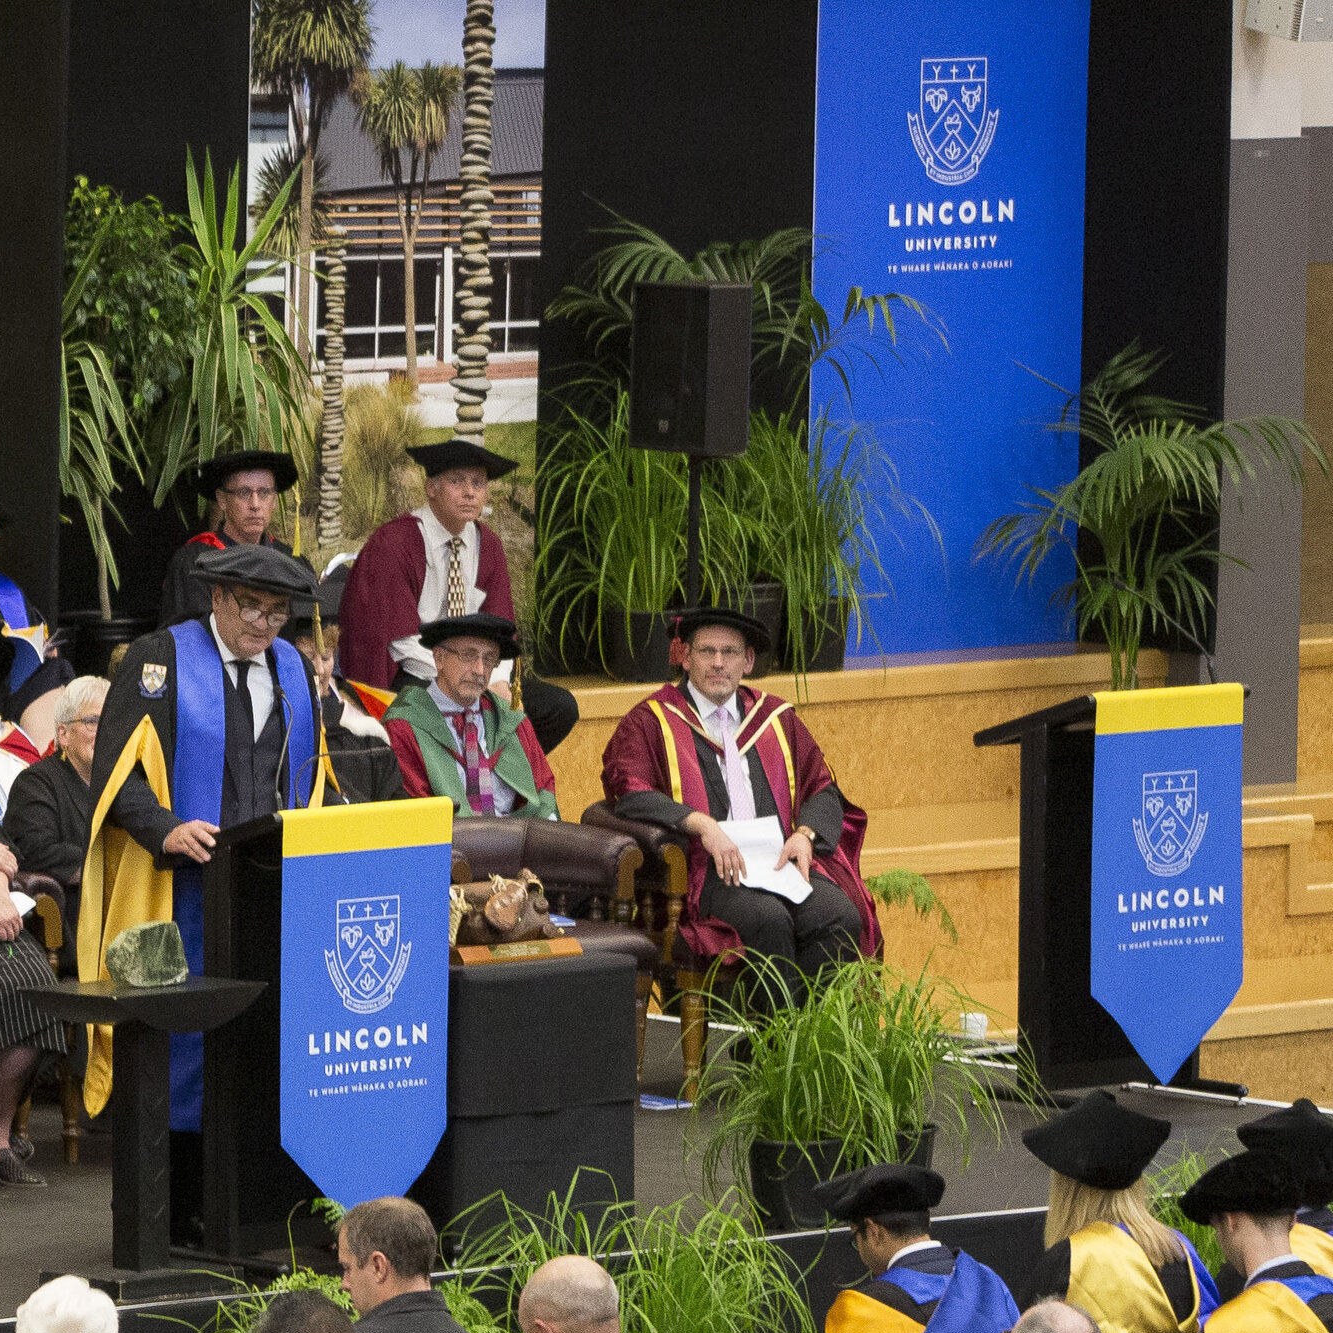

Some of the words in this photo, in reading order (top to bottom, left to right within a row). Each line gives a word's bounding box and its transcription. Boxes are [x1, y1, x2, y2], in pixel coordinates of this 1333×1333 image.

[888, 199, 1014, 228] LINCOLN
[905, 235, 998, 252] UNIVERSITY
[972, 260, 979, 270] O
[981, 259, 1013, 269] AORAKI
[1117, 885, 1225, 914] LINCOLN
[1131, 915, 1209, 933] UNIVERSITY
[307, 1022, 428, 1056] LINCOLN
[324, 1056, 413, 1076] UNIVERSITY
[396, 1077, 428, 1088] AORAKI
